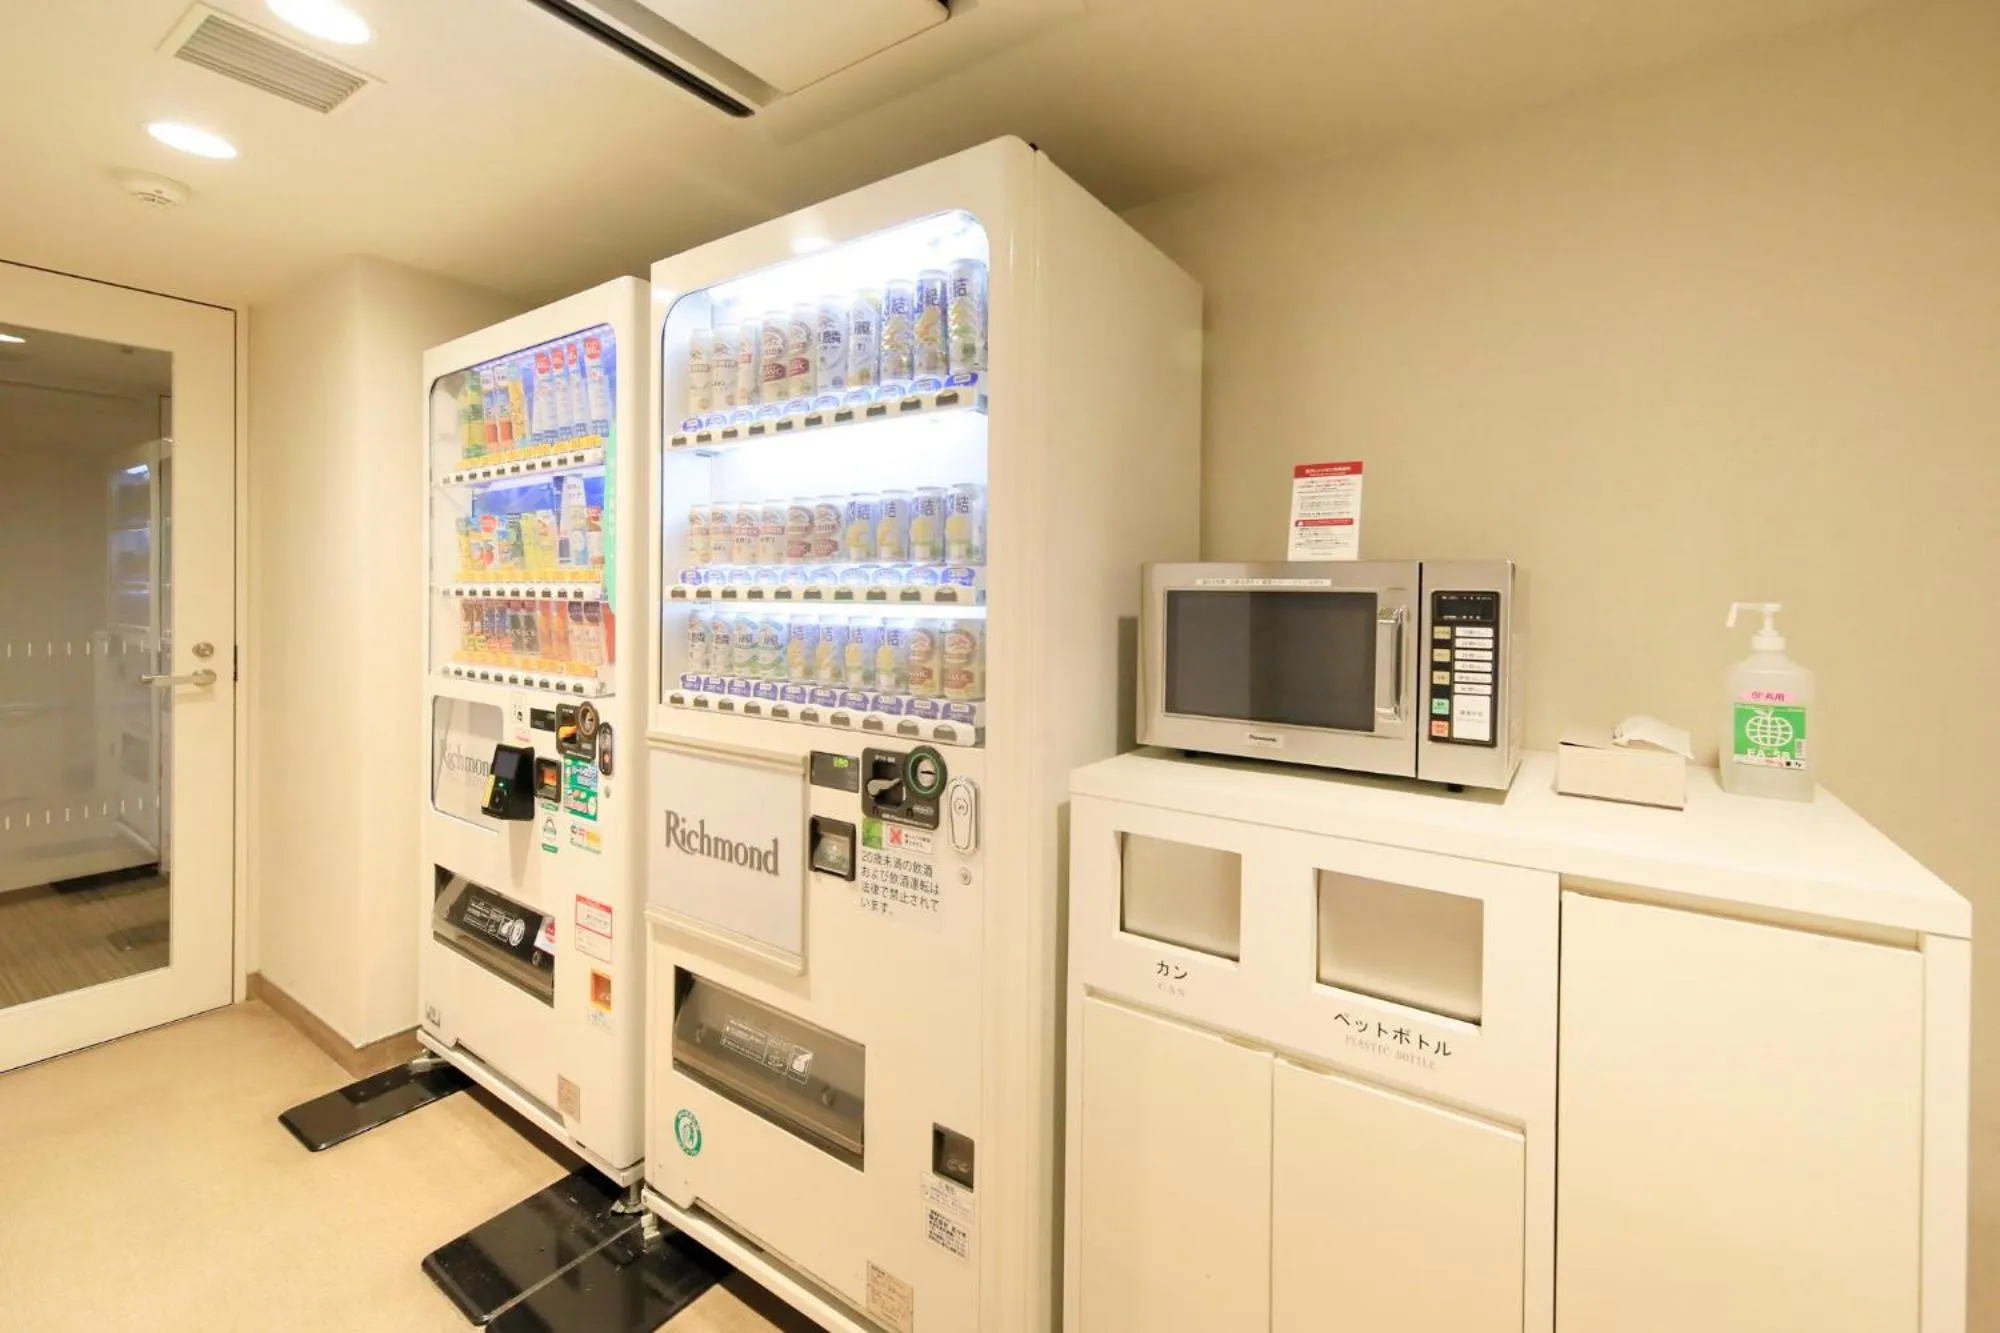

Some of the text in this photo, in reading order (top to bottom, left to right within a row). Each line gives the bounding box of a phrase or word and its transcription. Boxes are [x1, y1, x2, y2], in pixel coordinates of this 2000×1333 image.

[665, 809, 779, 876] Richmond
[860, 866, 940, 895] および飲酒運転は
[861, 852, 934, 878] 20歳未満の飲酒
[861, 881, 940, 913] 法律で禁止されて
[1157, 960, 1188, 980] カン
[1334, 1012, 1452, 1057] ペットボトル
[1344, 1034, 1437, 1069] PLASTIC BOTTLE
